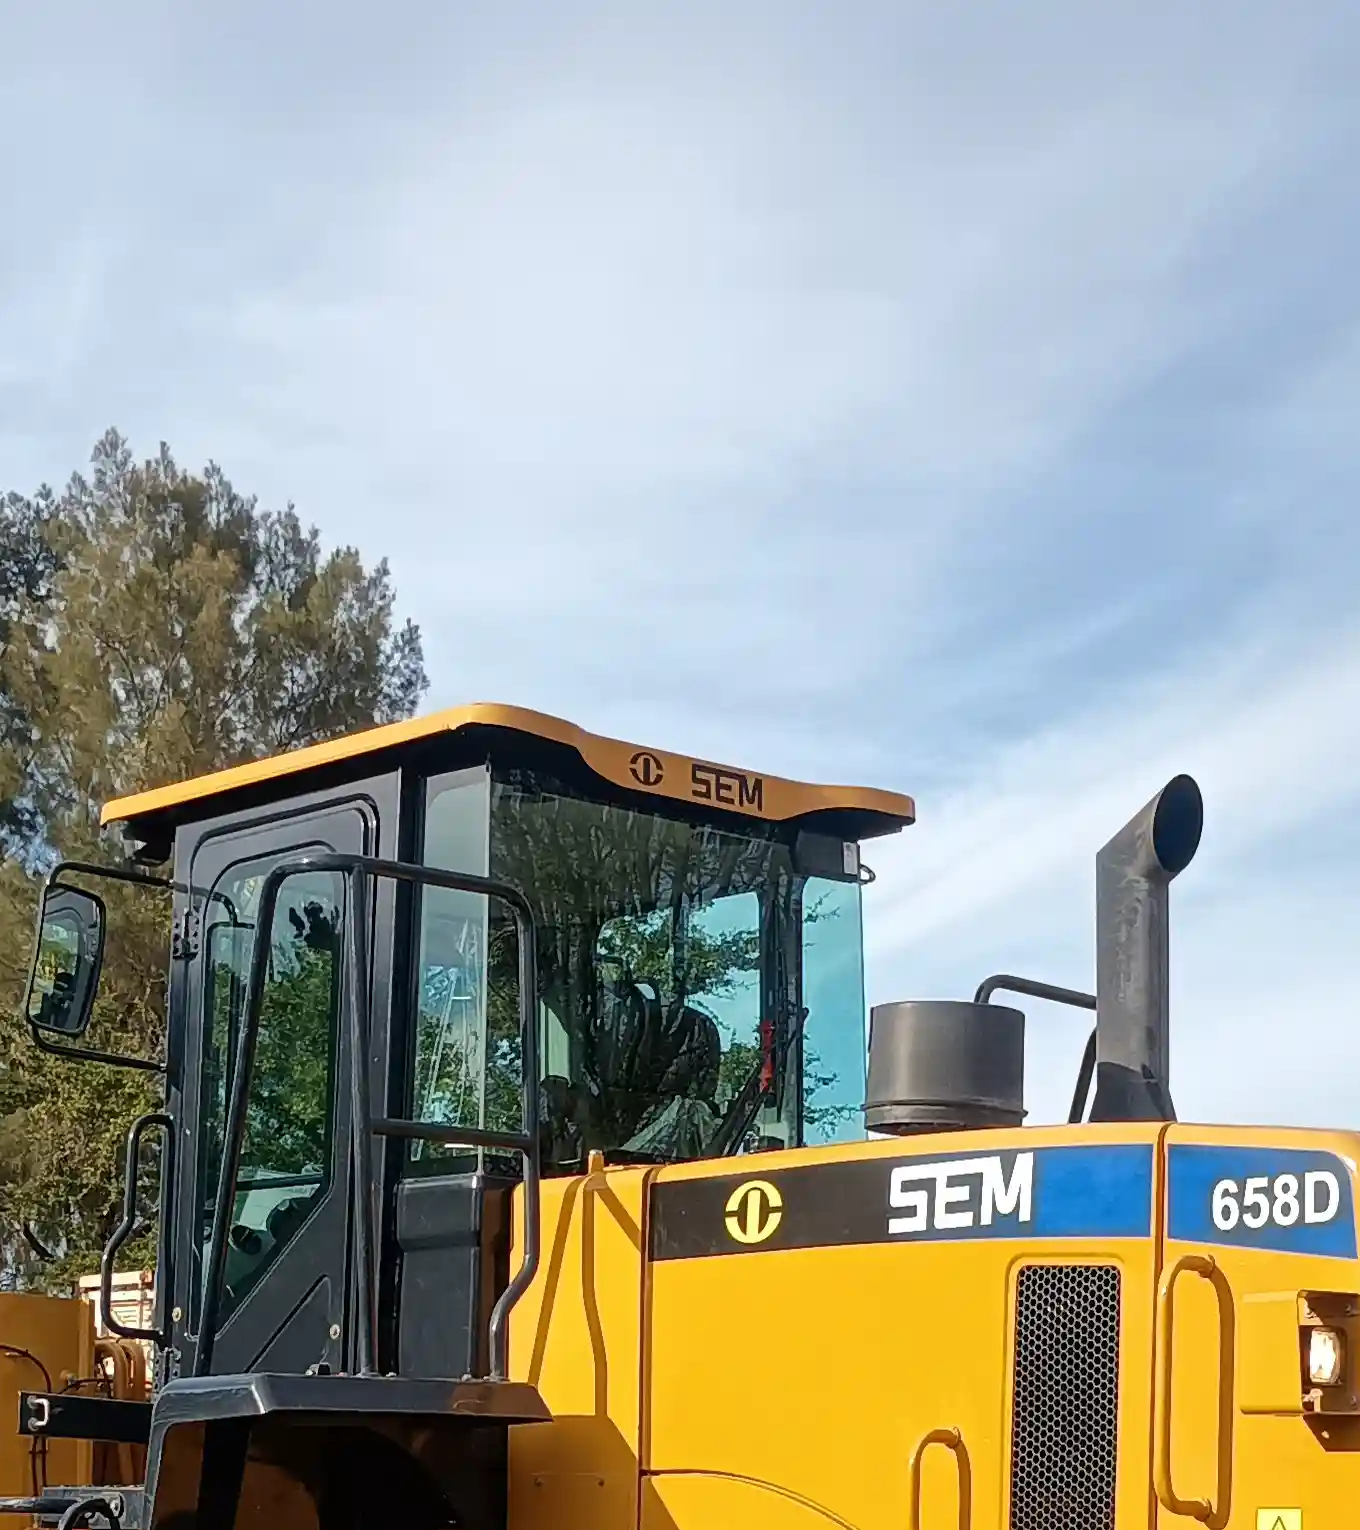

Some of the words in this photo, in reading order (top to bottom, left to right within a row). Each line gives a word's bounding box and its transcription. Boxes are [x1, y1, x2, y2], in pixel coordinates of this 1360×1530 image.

[691, 763, 763, 812] SEM
[888, 1151, 1034, 1235] SEM
[1212, 1170, 1340, 1231] 658D
